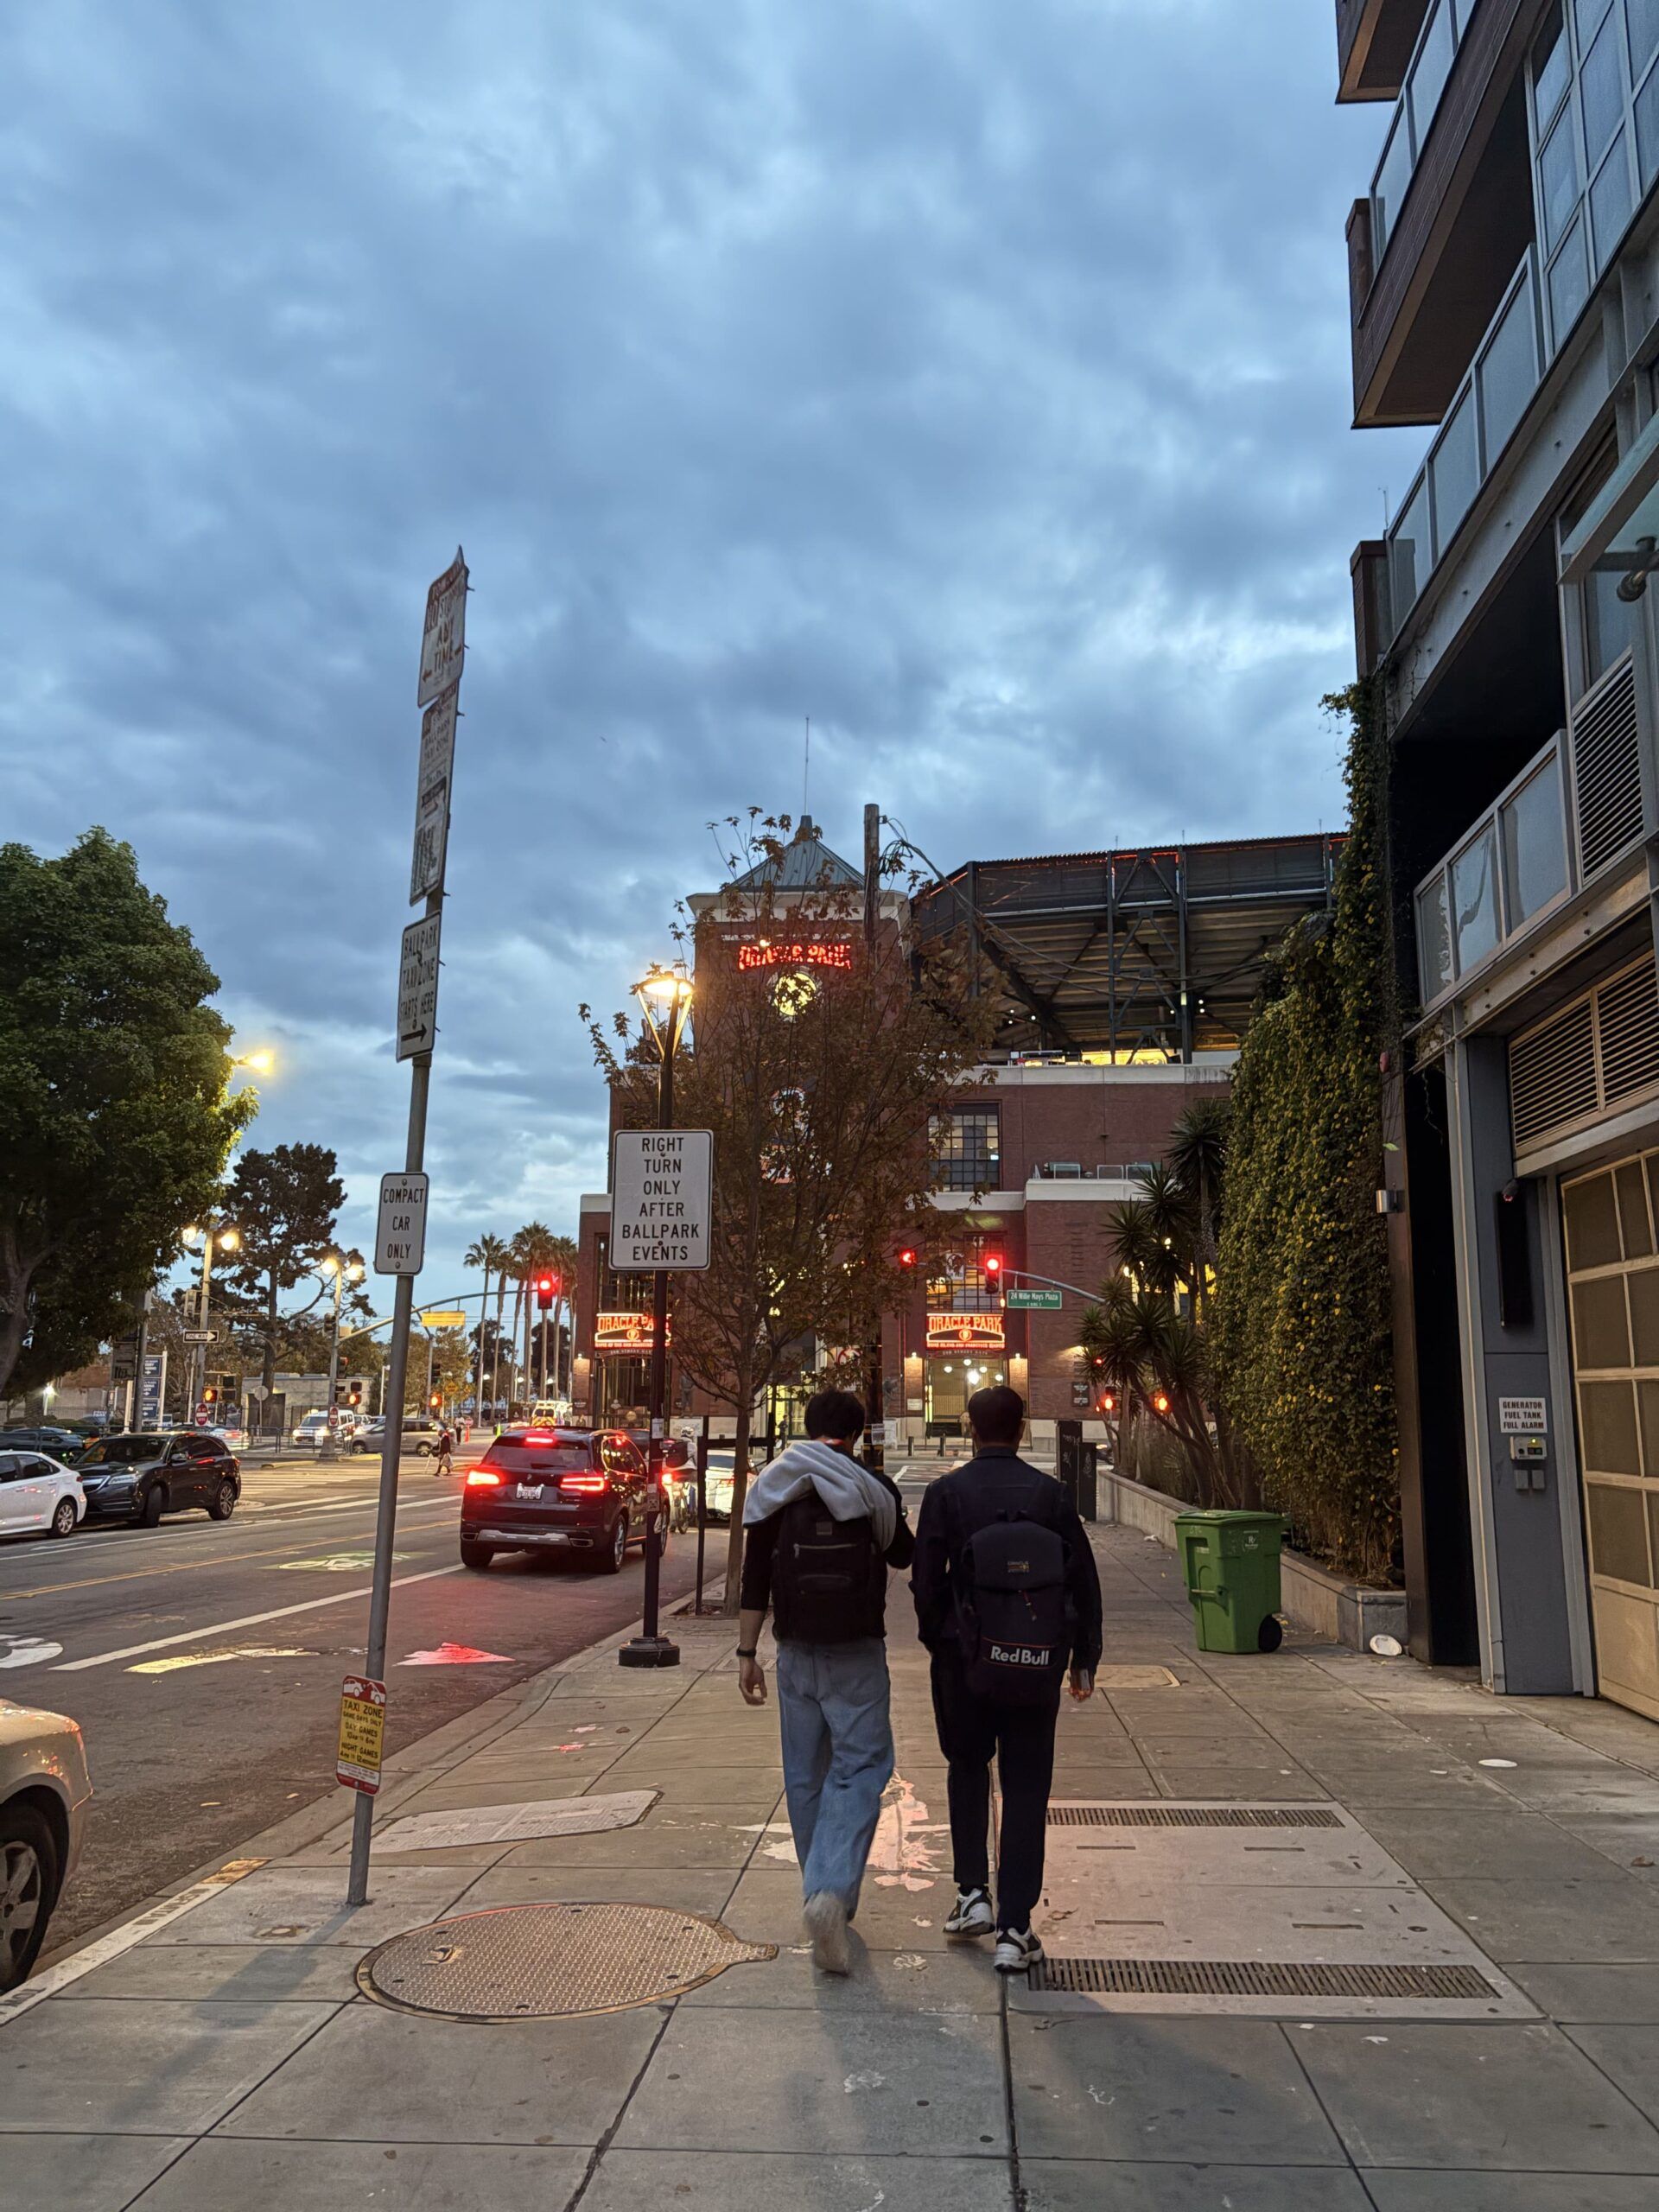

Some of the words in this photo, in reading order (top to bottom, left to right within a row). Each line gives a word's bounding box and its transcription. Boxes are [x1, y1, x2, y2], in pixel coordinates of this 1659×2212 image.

[404, 923, 437, 960] BALLPARK
[403, 964, 417, 991] TAXI
[418, 958, 435, 986] ZONE
[400, 997, 418, 1021] STARTS
[420, 991, 434, 1015] HERE
[642, 1137, 684, 1152] RIGHT
[644, 1159, 682, 1173] TURN
[643, 1180, 681, 1195] ONLY
[383, 1188, 424, 1204] COMPACT
[639, 1202, 684, 1217] AFTER
[392, 1216, 410, 1231] CAR
[622, 1224, 700, 1239] BALLPARK
[387, 1243, 411, 1259] ONLY
[632, 1245, 689, 1261] EVENTS
[1019, 1292, 1031, 1300] Willie
[1032, 1293, 1044, 1302] Mays
[597, 1316, 639, 1332] ORACLE
[929, 1316, 971, 1332] ORACLE
[973, 1316, 1002, 1333] PARK
[1523, 1411, 1541, 1420] TANK
[990, 1645, 1020, 1662] Red
[1020, 1649, 1050, 1665] Bull
[344, 1700, 360, 1712] TAXI
[363, 1705, 383, 1719] ZONE
[346, 1721, 357, 1731] DAY
[359, 1726, 378, 1738] GAMES
[341, 1742, 357, 1751] NIGHT
[359, 1747, 378, 1758] GAMES
